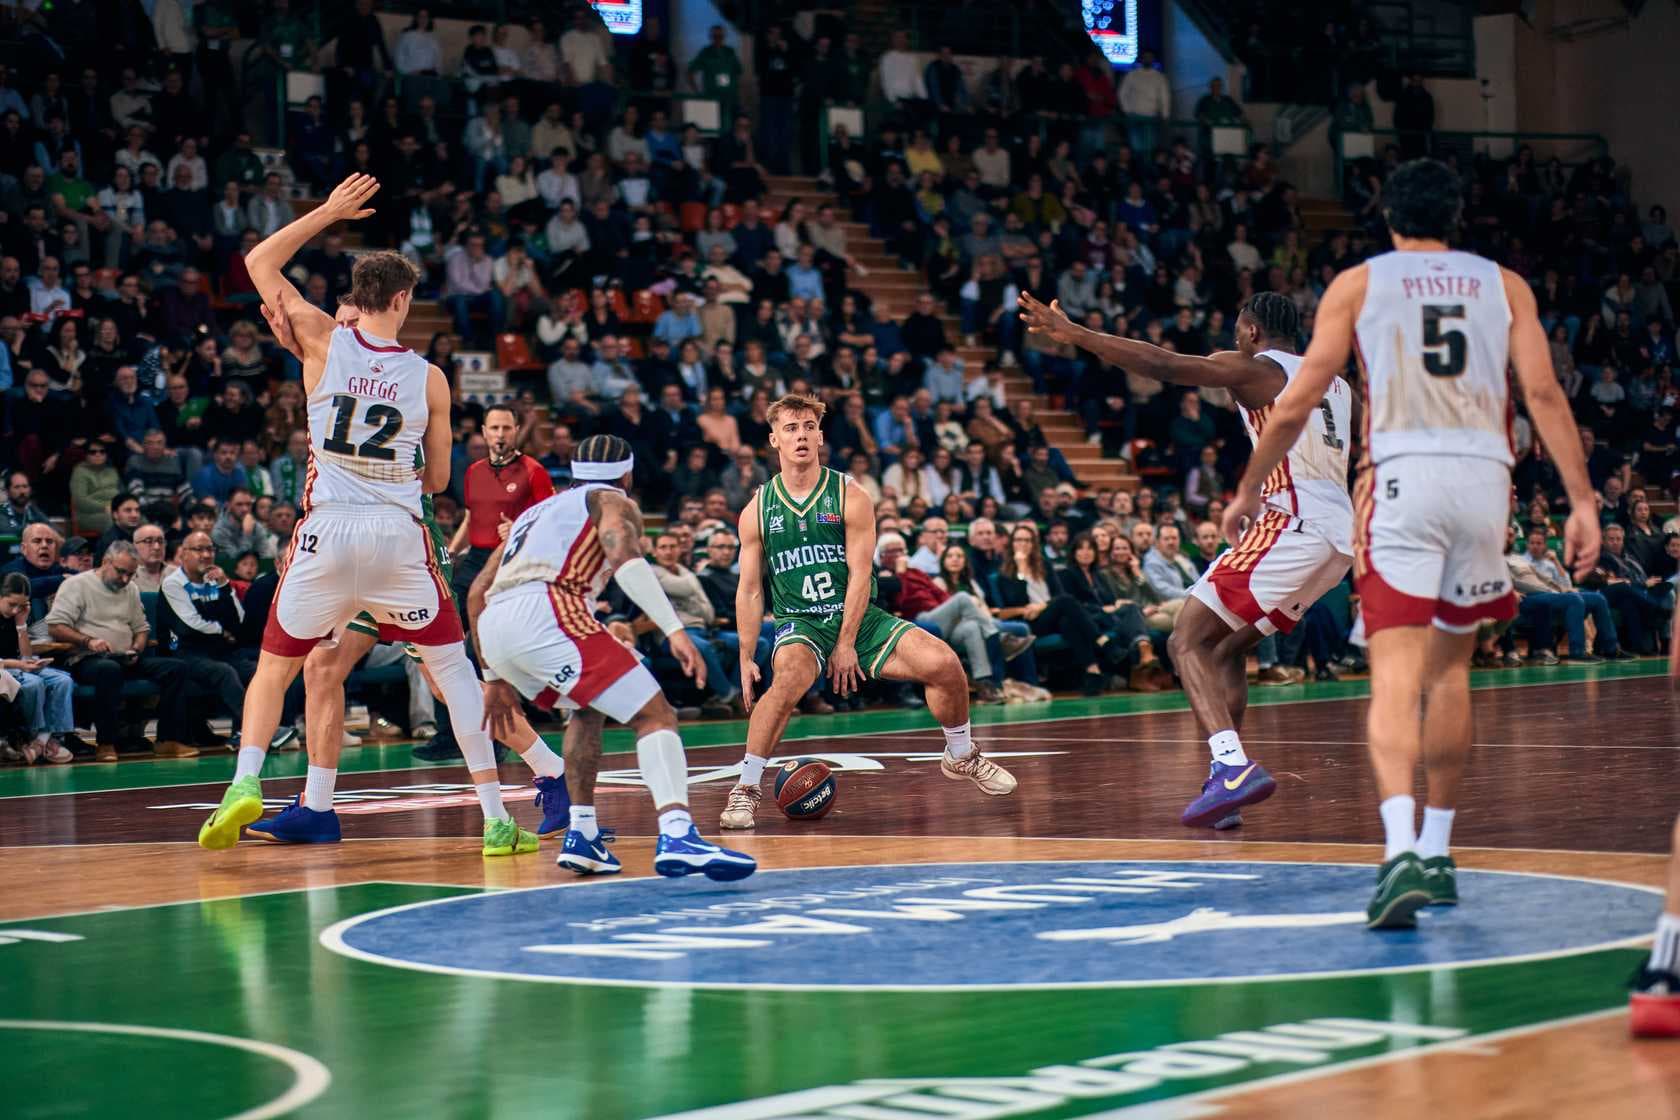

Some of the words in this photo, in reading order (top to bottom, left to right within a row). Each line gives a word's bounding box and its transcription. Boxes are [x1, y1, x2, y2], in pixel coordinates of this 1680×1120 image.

[1402, 274, 1481, 299] PFISTER
[1421, 303, 1468, 378] 5
[348, 376, 399, 402] GREGG
[323, 394, 404, 462] 12
[1386, 478, 1399, 500] 5
[300, 533, 318, 553] 12
[770, 544, 847, 576] LIMOGES
[801, 571, 836, 602] 42
[1469, 580, 1505, 596] LCR
[399, 607, 430, 622] LCR
[519, 869, 1262, 961] HUMAN
